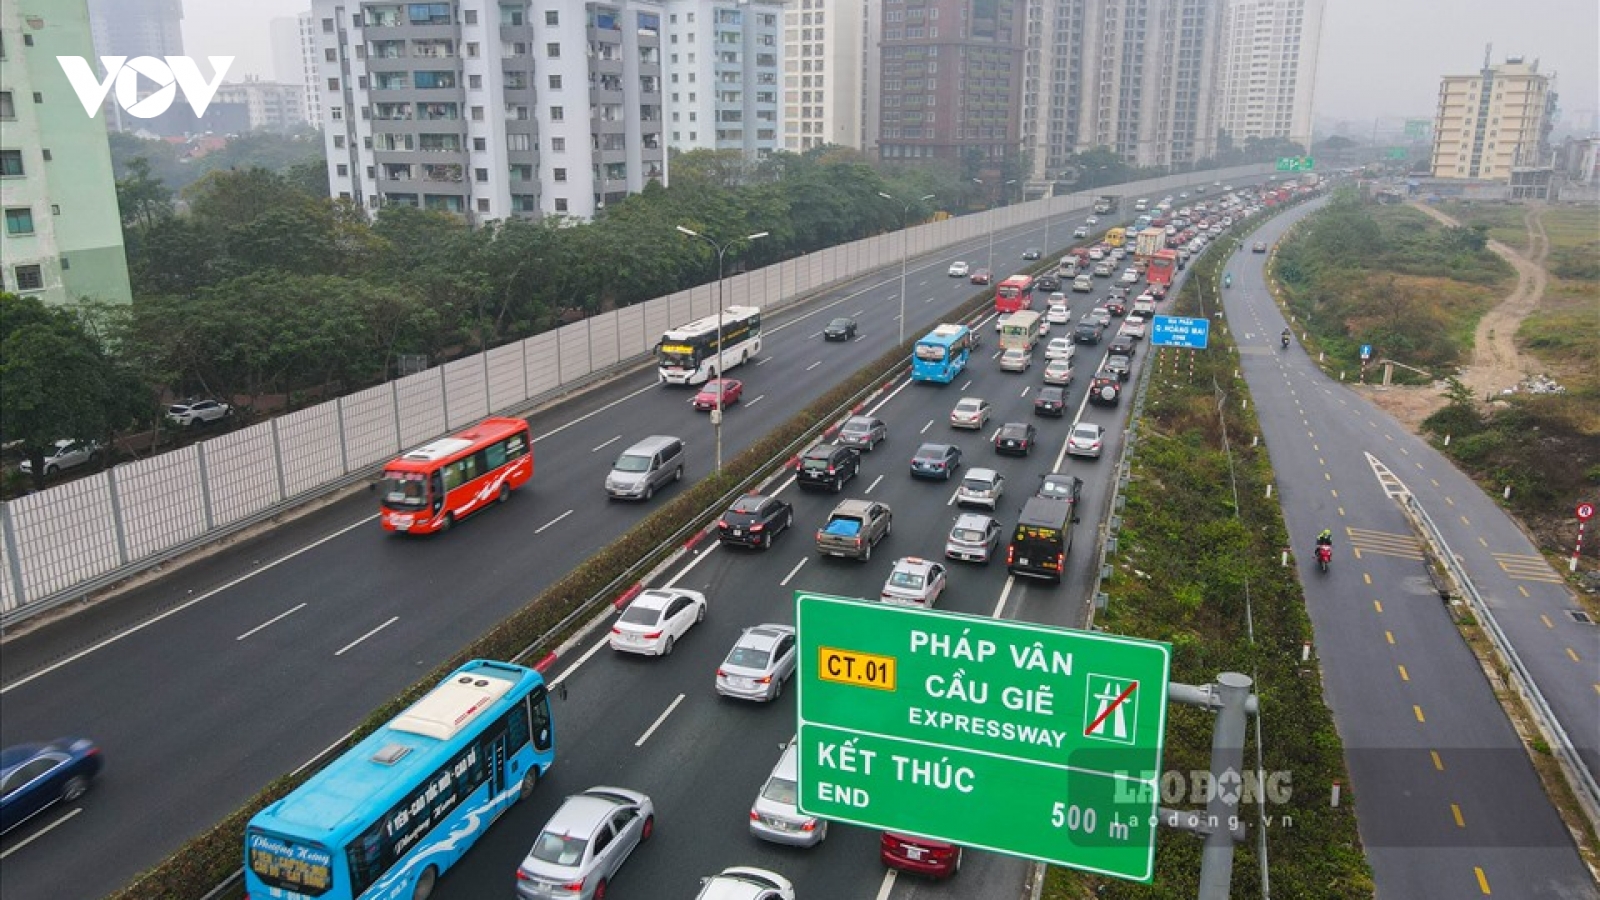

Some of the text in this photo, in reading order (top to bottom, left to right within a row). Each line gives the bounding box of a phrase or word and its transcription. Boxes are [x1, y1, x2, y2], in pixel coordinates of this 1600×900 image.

[827, 655, 887, 683] CT.01
[910, 628, 1073, 676] PHÁP VÂN
[925, 668, 1054, 716] CẦU GIẼ
[909, 706, 1067, 749] EXPRESSWAY
[817, 737, 975, 793] KẾT THÚC
[817, 781, 870, 808] END
[1051, 801, 1129, 840] 500 m
